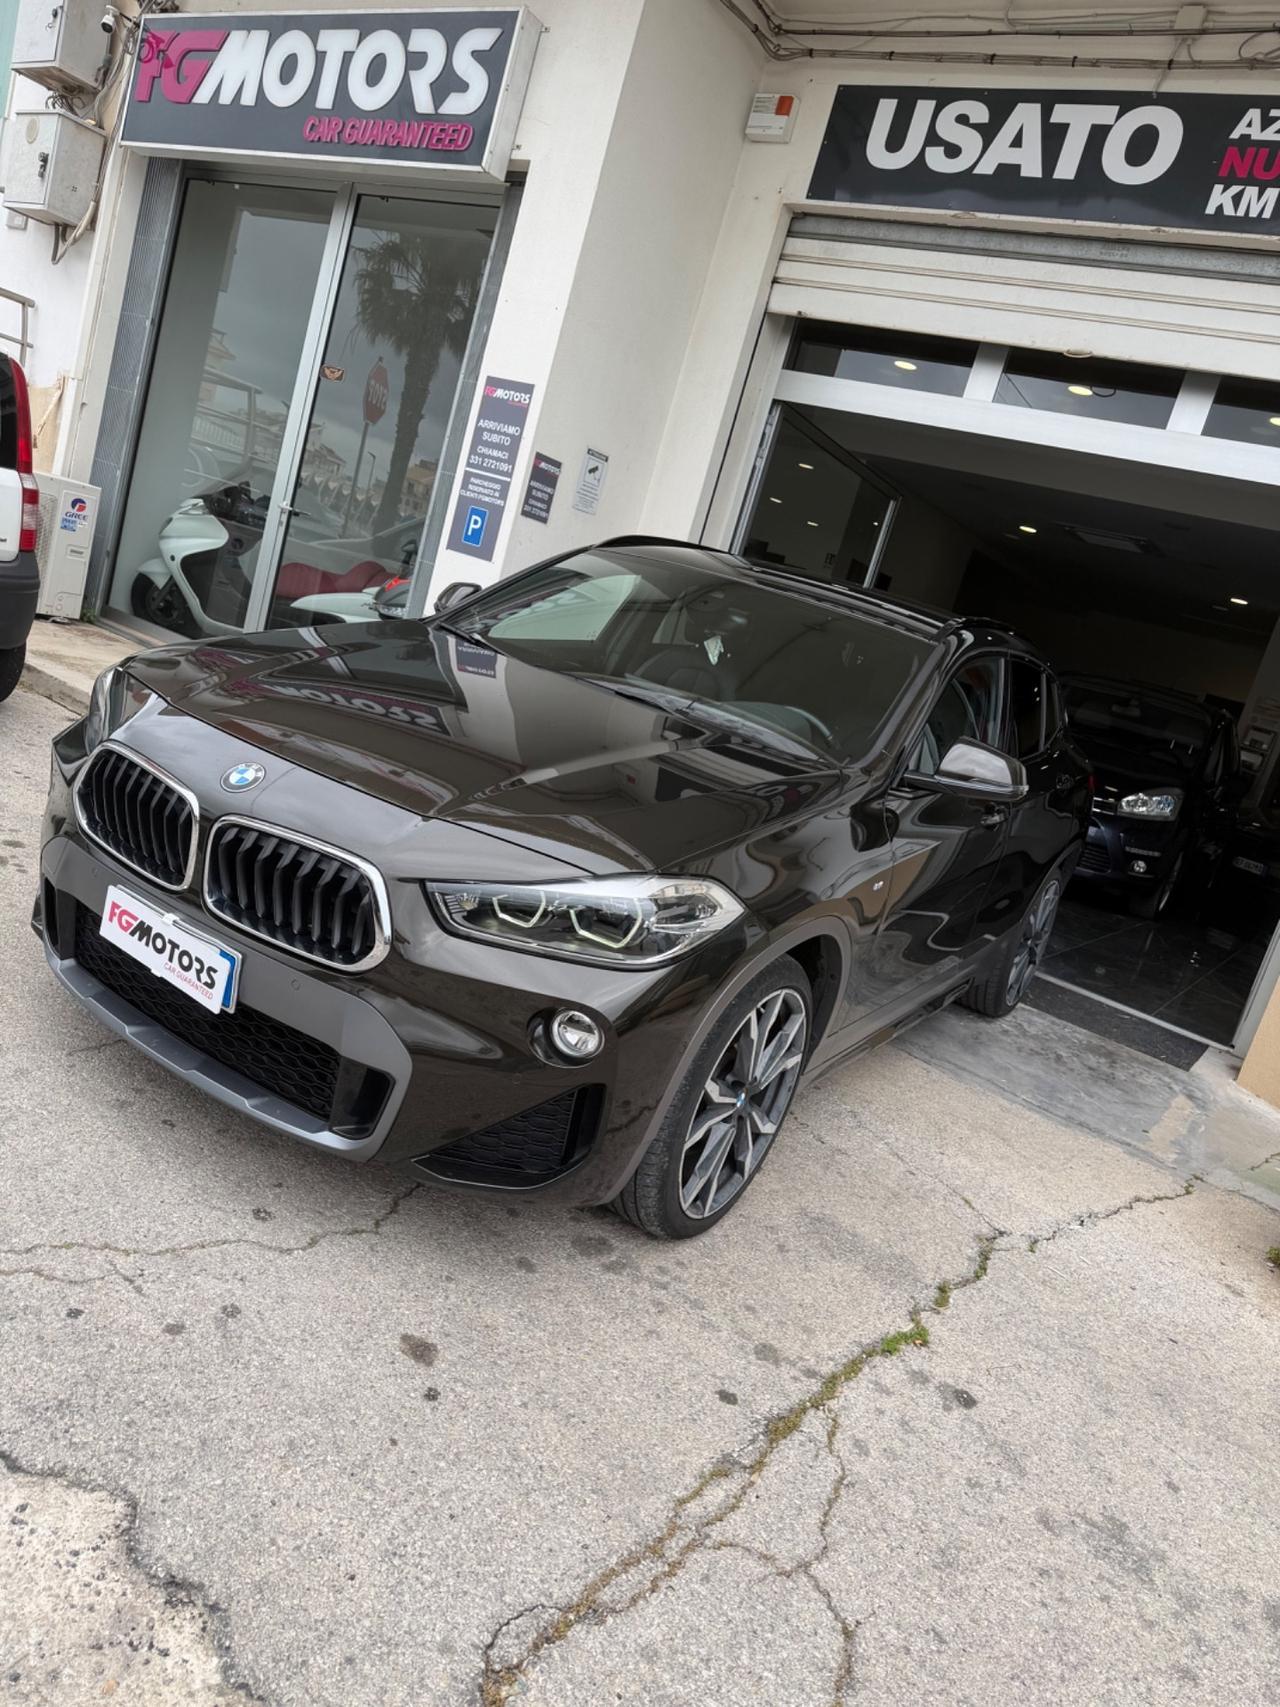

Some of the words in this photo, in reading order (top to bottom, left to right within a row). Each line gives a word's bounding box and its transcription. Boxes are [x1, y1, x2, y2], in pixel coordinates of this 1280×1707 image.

[135, 28, 503, 115] FGMOTORS
[303, 116, 343, 144] CAR
[343, 117, 474, 151] GUARANTEED
[866, 98, 1184, 185] USATO
[1218, 146, 1280, 181] NU
[1204, 184, 1280, 219] KM
[478, 419, 521, 436] ARRIVIAMO
[482, 431, 511, 446] SUBITO
[469, 454, 482, 465] 331
[467, 514, 482, 536] P
[108, 900, 218, 990] FGMOTORS
[163, 962, 179, 976] CAR
